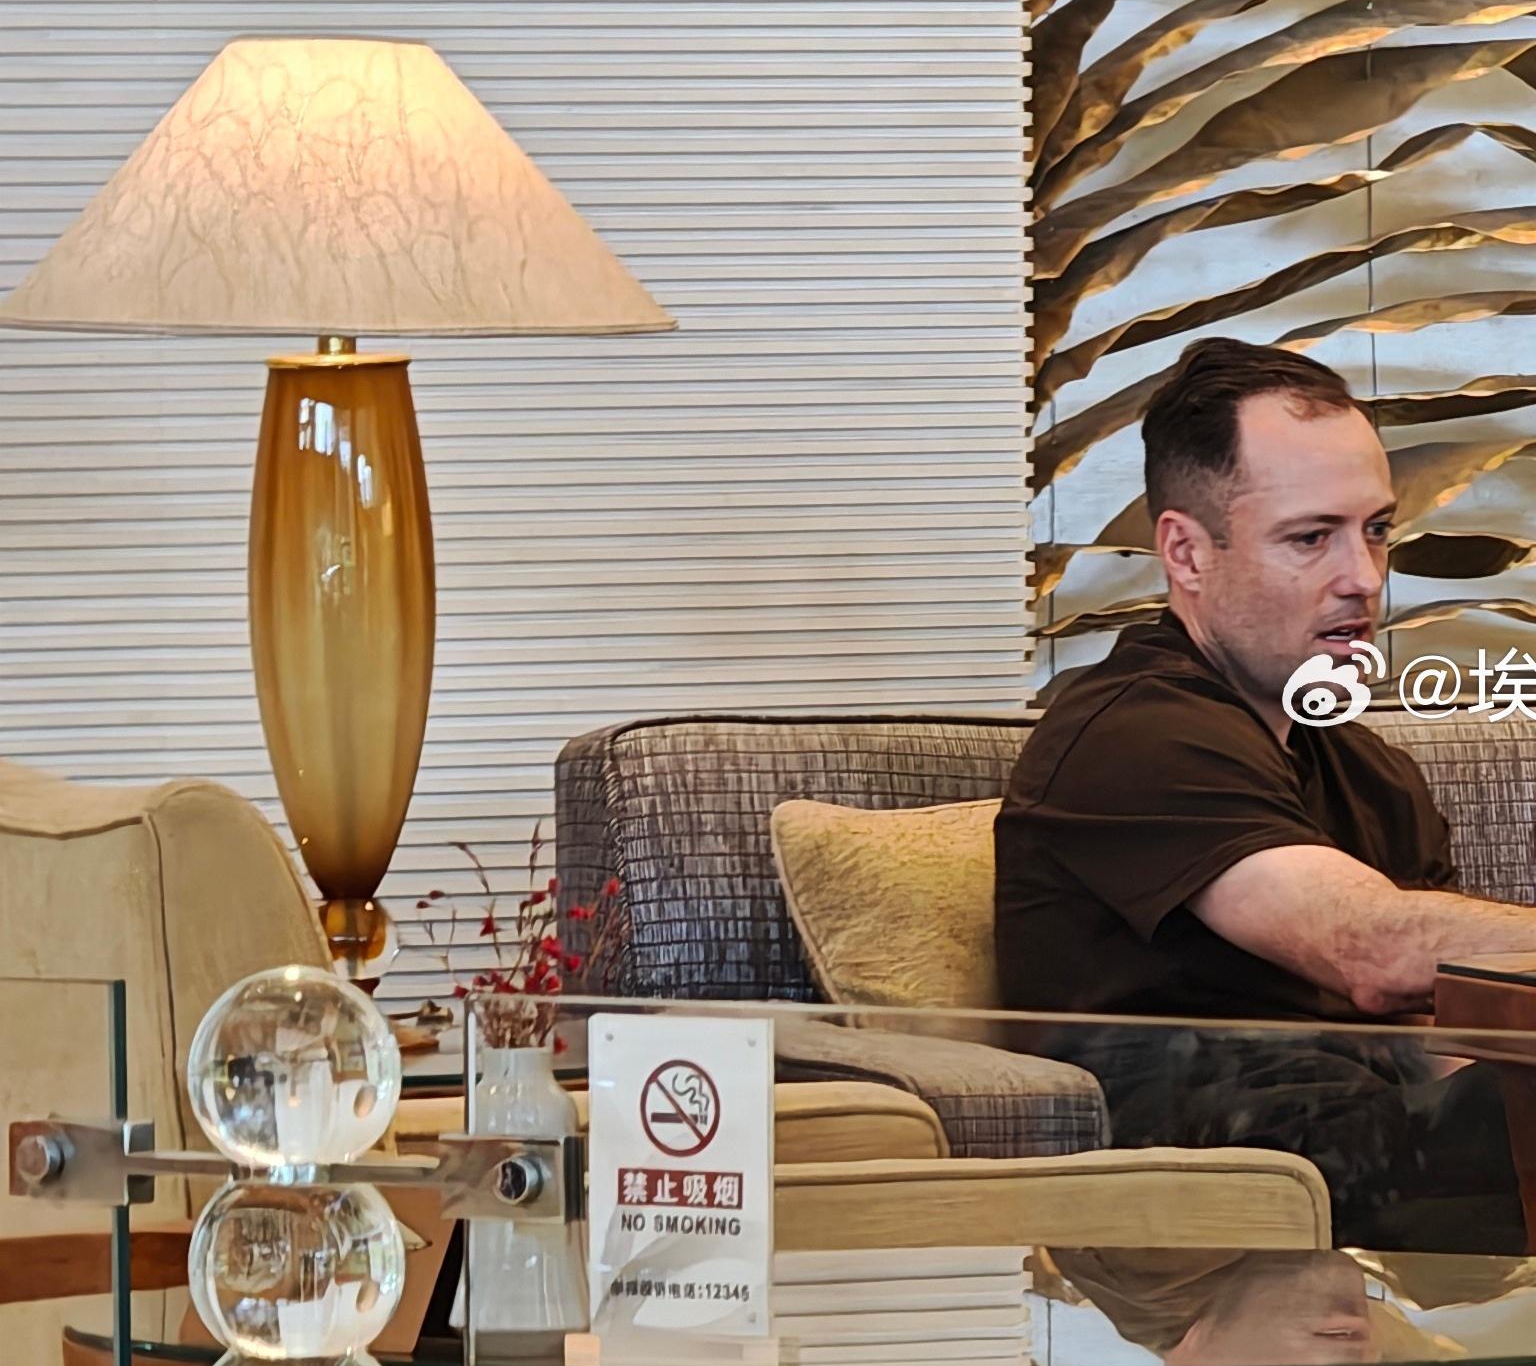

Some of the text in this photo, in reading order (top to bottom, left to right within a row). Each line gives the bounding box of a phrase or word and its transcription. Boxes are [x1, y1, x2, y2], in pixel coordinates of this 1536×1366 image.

[623, 1172, 739, 1206] 禁止吸烟
[620, 1212, 741, 1235] NO SMOKING
